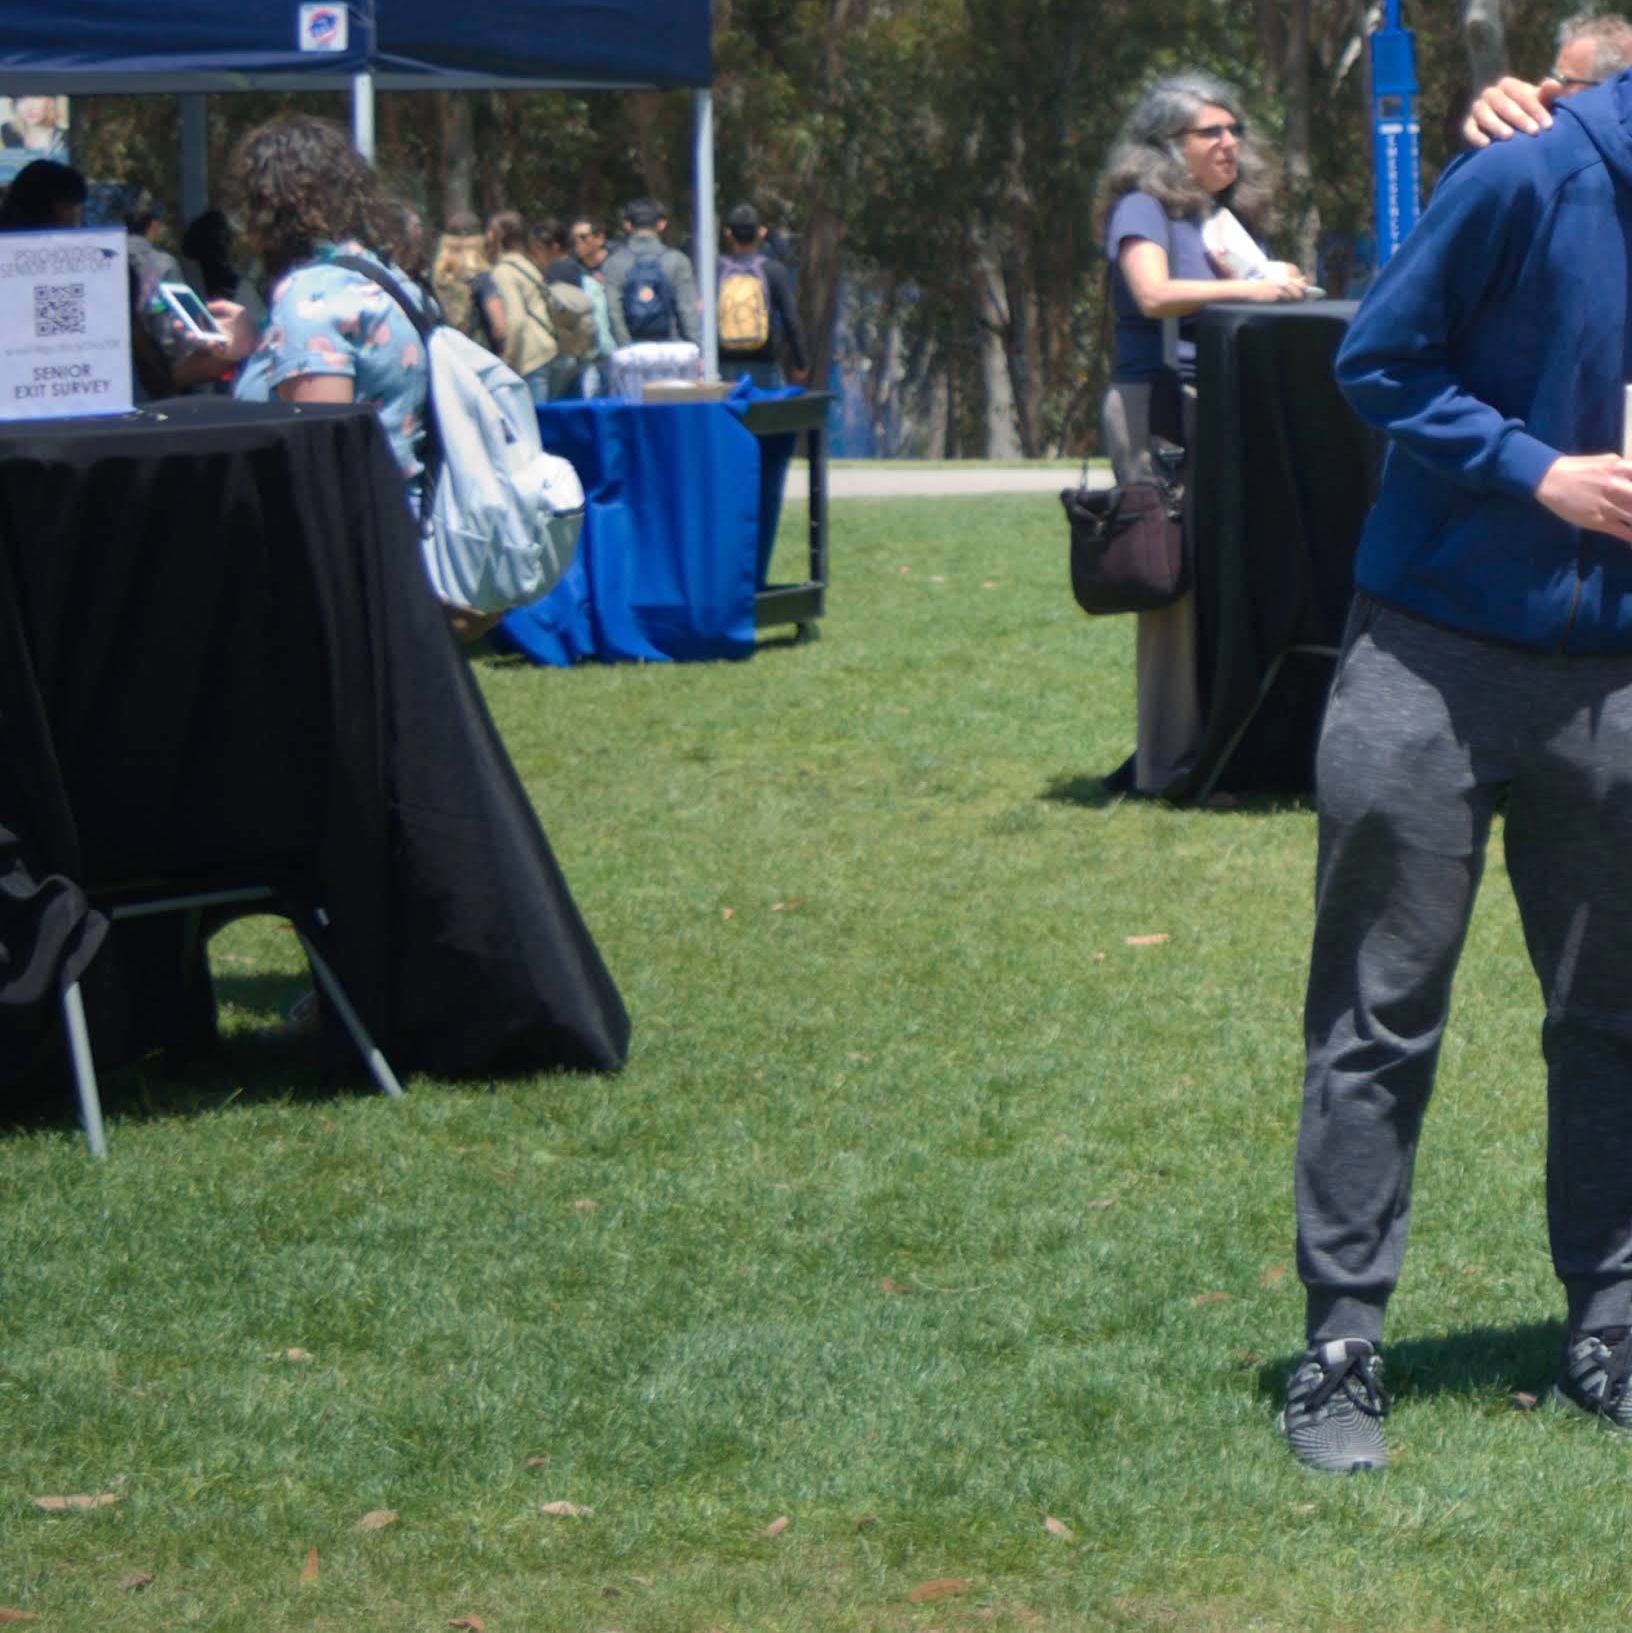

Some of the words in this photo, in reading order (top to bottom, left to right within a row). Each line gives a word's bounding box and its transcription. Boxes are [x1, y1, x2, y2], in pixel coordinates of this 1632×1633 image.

[33, 364, 91, 381] SENIOR
[14, 384, 46, 399] EXIT
[51, 379, 111, 397] SURVEY
